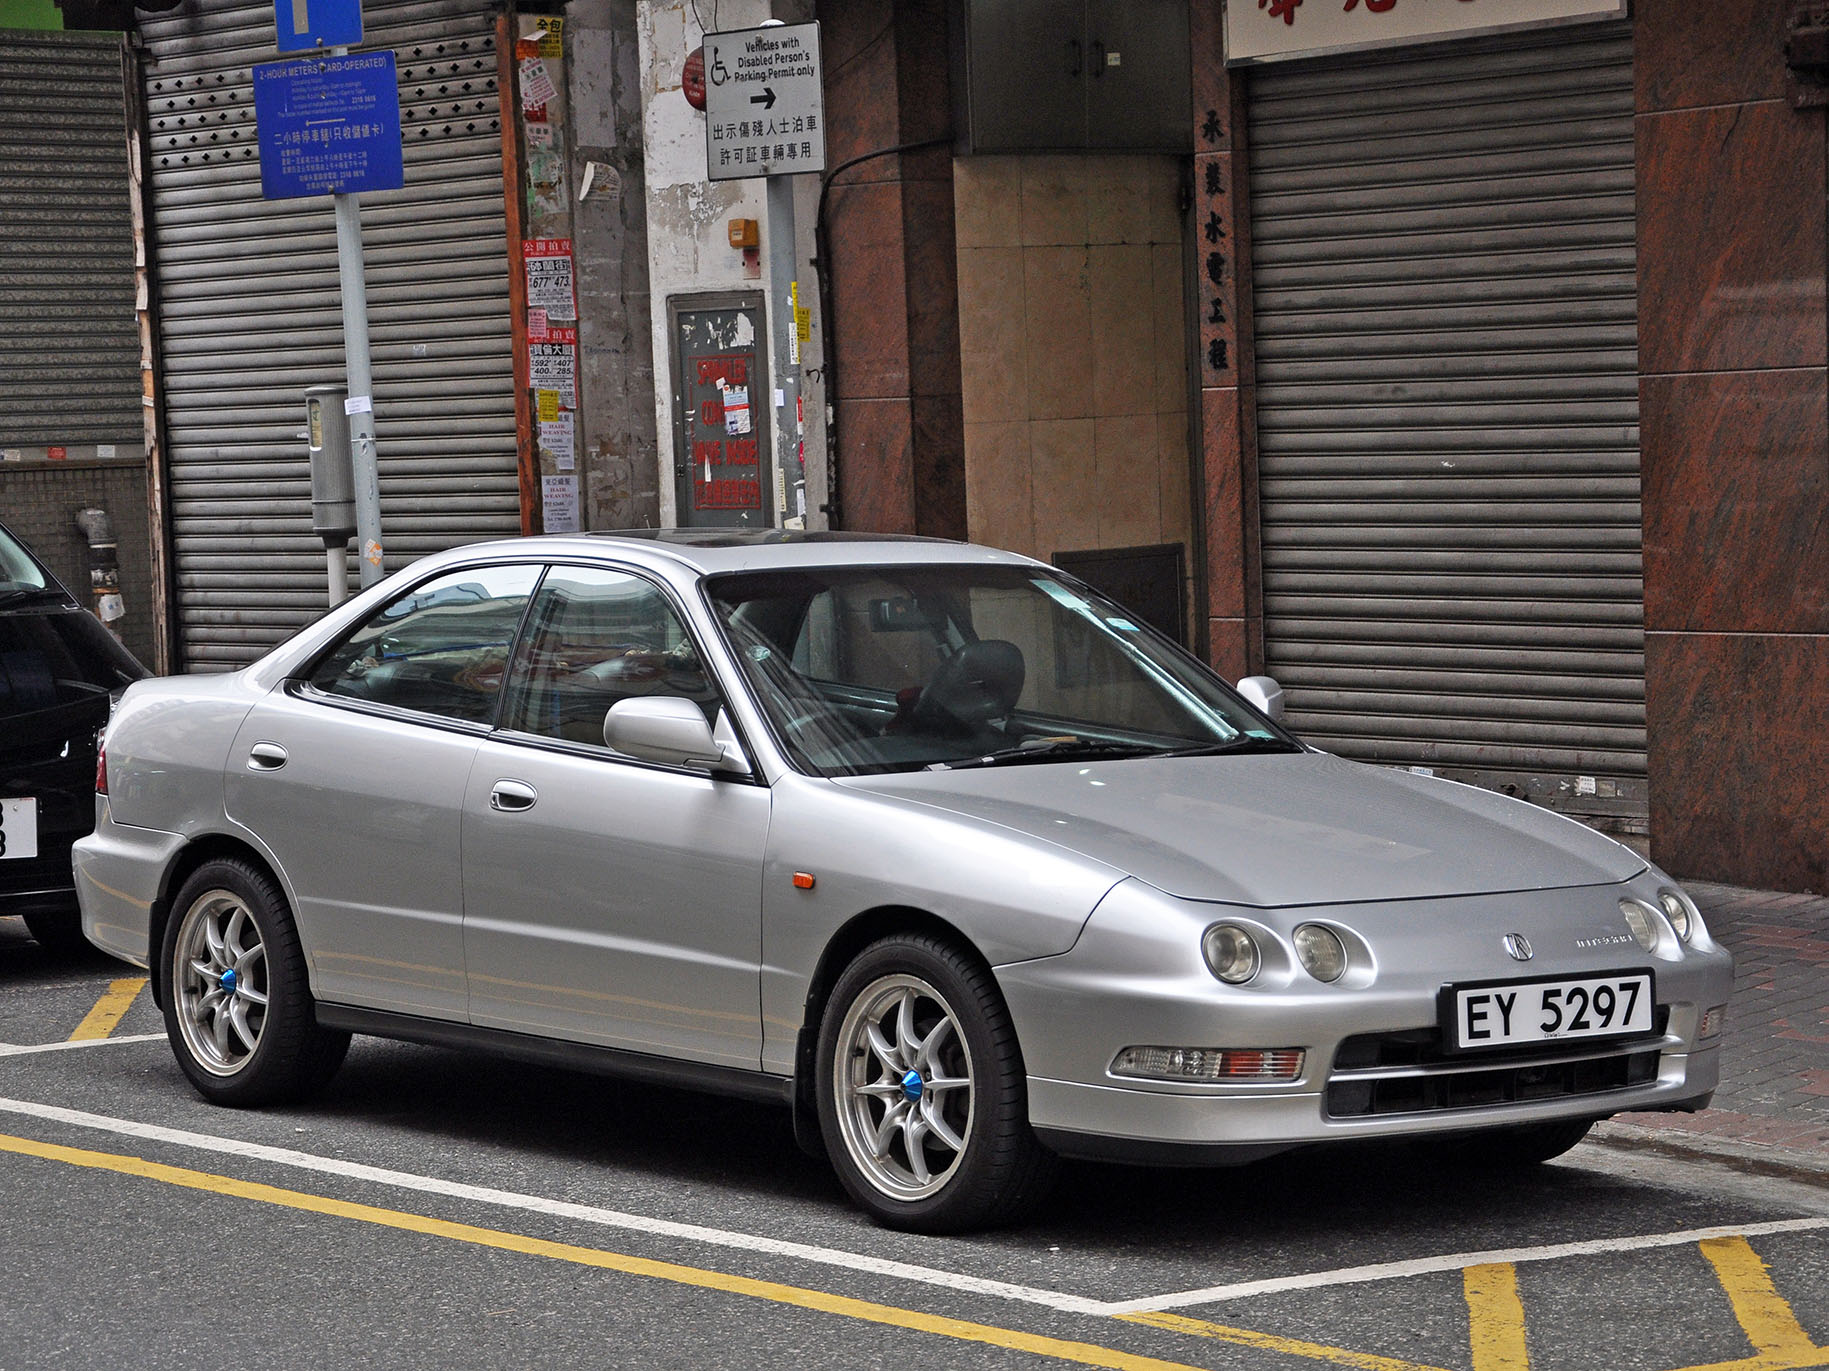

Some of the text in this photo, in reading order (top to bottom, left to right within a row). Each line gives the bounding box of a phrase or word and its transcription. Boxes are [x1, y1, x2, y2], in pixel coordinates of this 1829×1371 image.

[537, 18, 560, 32] 全包
[745, 37, 800, 53] Vehicles with
[259, 55, 387, 80] 2-HOUR METERS (ARD-OPERATED)
[738, 50, 810, 68] Disabled Person's
[734, 64, 815, 83] Parking Permit only
[713, 115, 818, 140] 出示傷殘人士泊車
[720, 141, 811, 166] 許可証車輛專用
[533, 276, 570, 288] 677 473
[1466, 981, 1642, 1040] EY 5297
